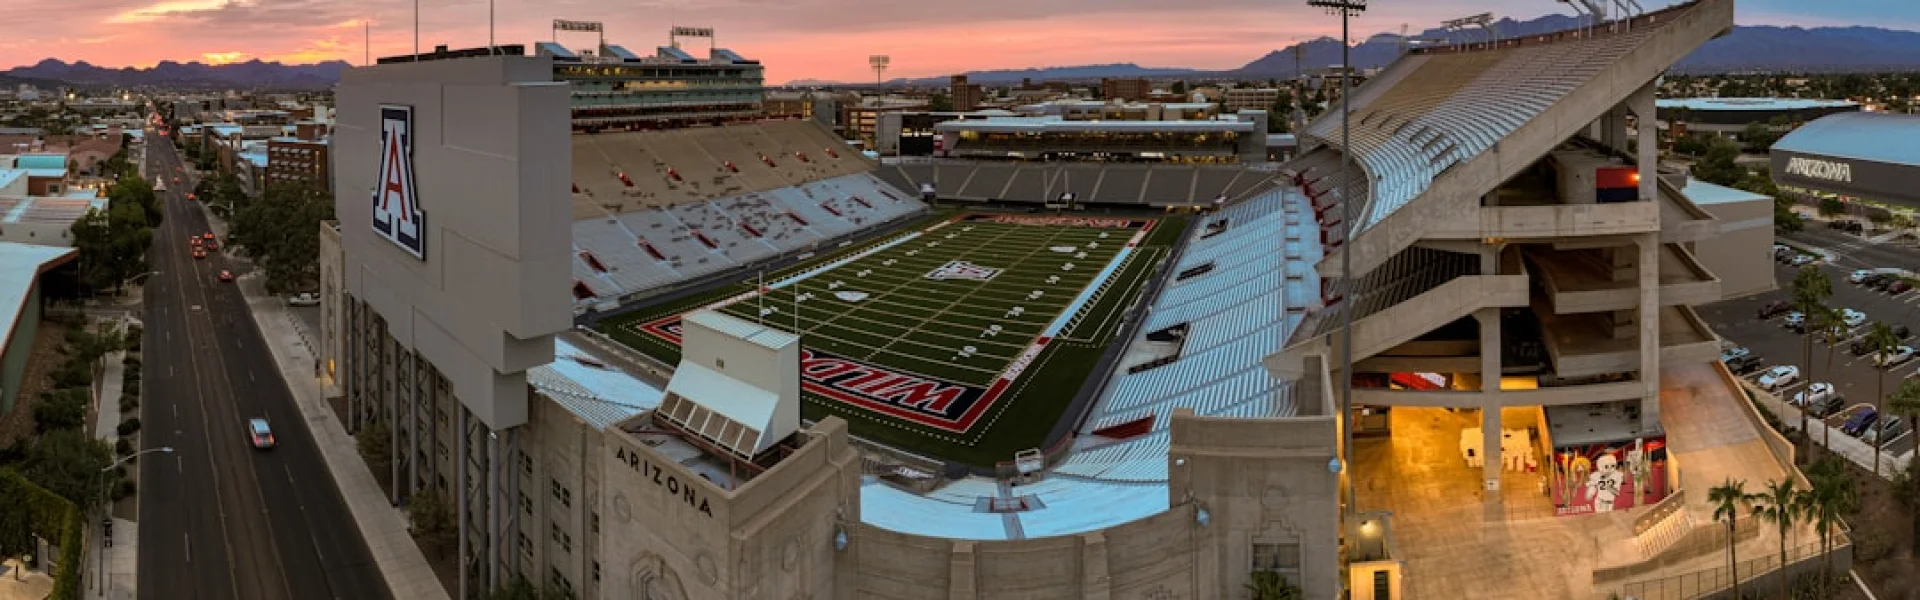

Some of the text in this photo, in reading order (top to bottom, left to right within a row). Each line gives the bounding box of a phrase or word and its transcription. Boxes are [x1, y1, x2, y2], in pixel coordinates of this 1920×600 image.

[372, 104, 423, 260] A
[1785, 157, 1851, 182] ARIZONA
[616, 446, 713, 518] ARIZONA
